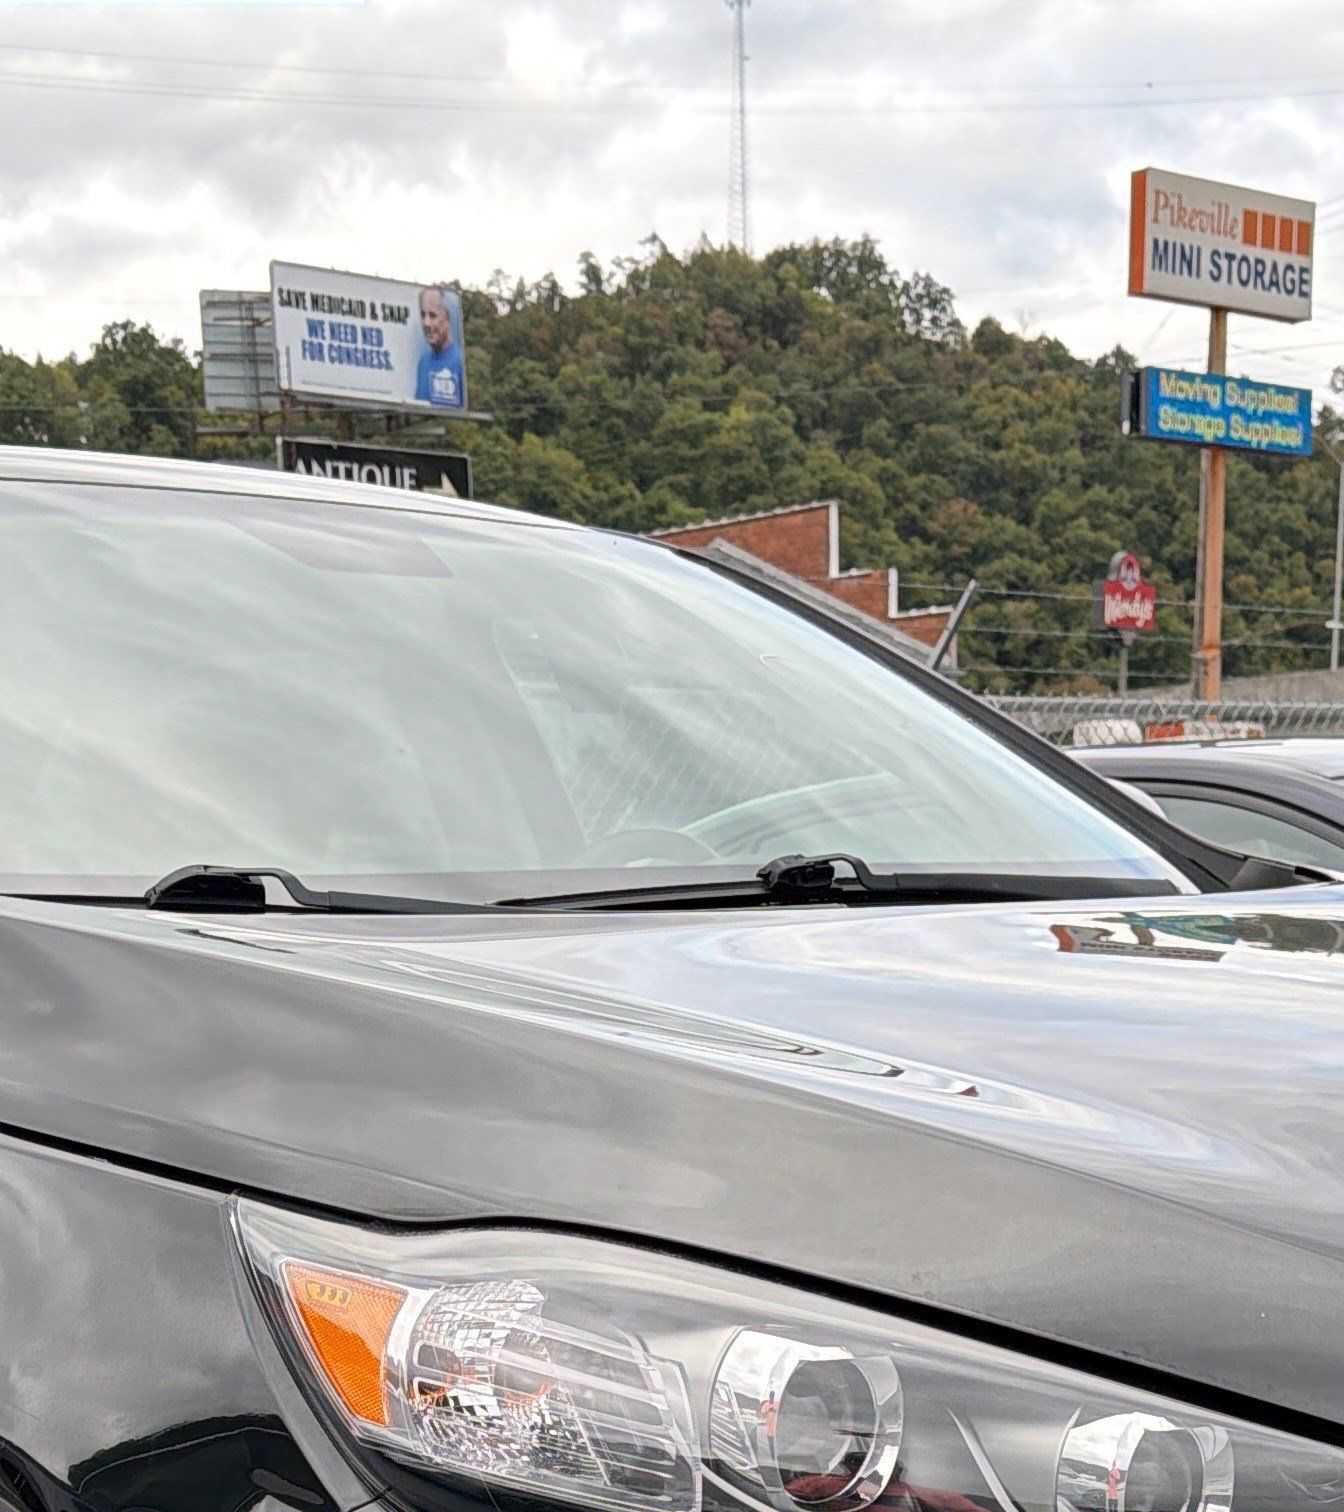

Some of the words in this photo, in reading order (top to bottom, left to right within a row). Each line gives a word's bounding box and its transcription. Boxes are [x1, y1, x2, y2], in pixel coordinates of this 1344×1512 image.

[1152, 189, 1239, 239] Pikeville
[1151, 236, 1202, 280] MINI
[1208, 248, 1311, 298] STORAGE
[277, 286, 308, 311] SAVE
[310, 292, 367, 319] MEDICAID
[369, 301, 379, 321] &
[380, 303, 410, 325] SNAP
[301, 338, 326, 362] FOR
[307, 318, 327, 341] WE
[328, 320, 358, 344] NEED
[1159, 371, 1222, 410] Moving
[1158, 403, 1227, 442] Storage
